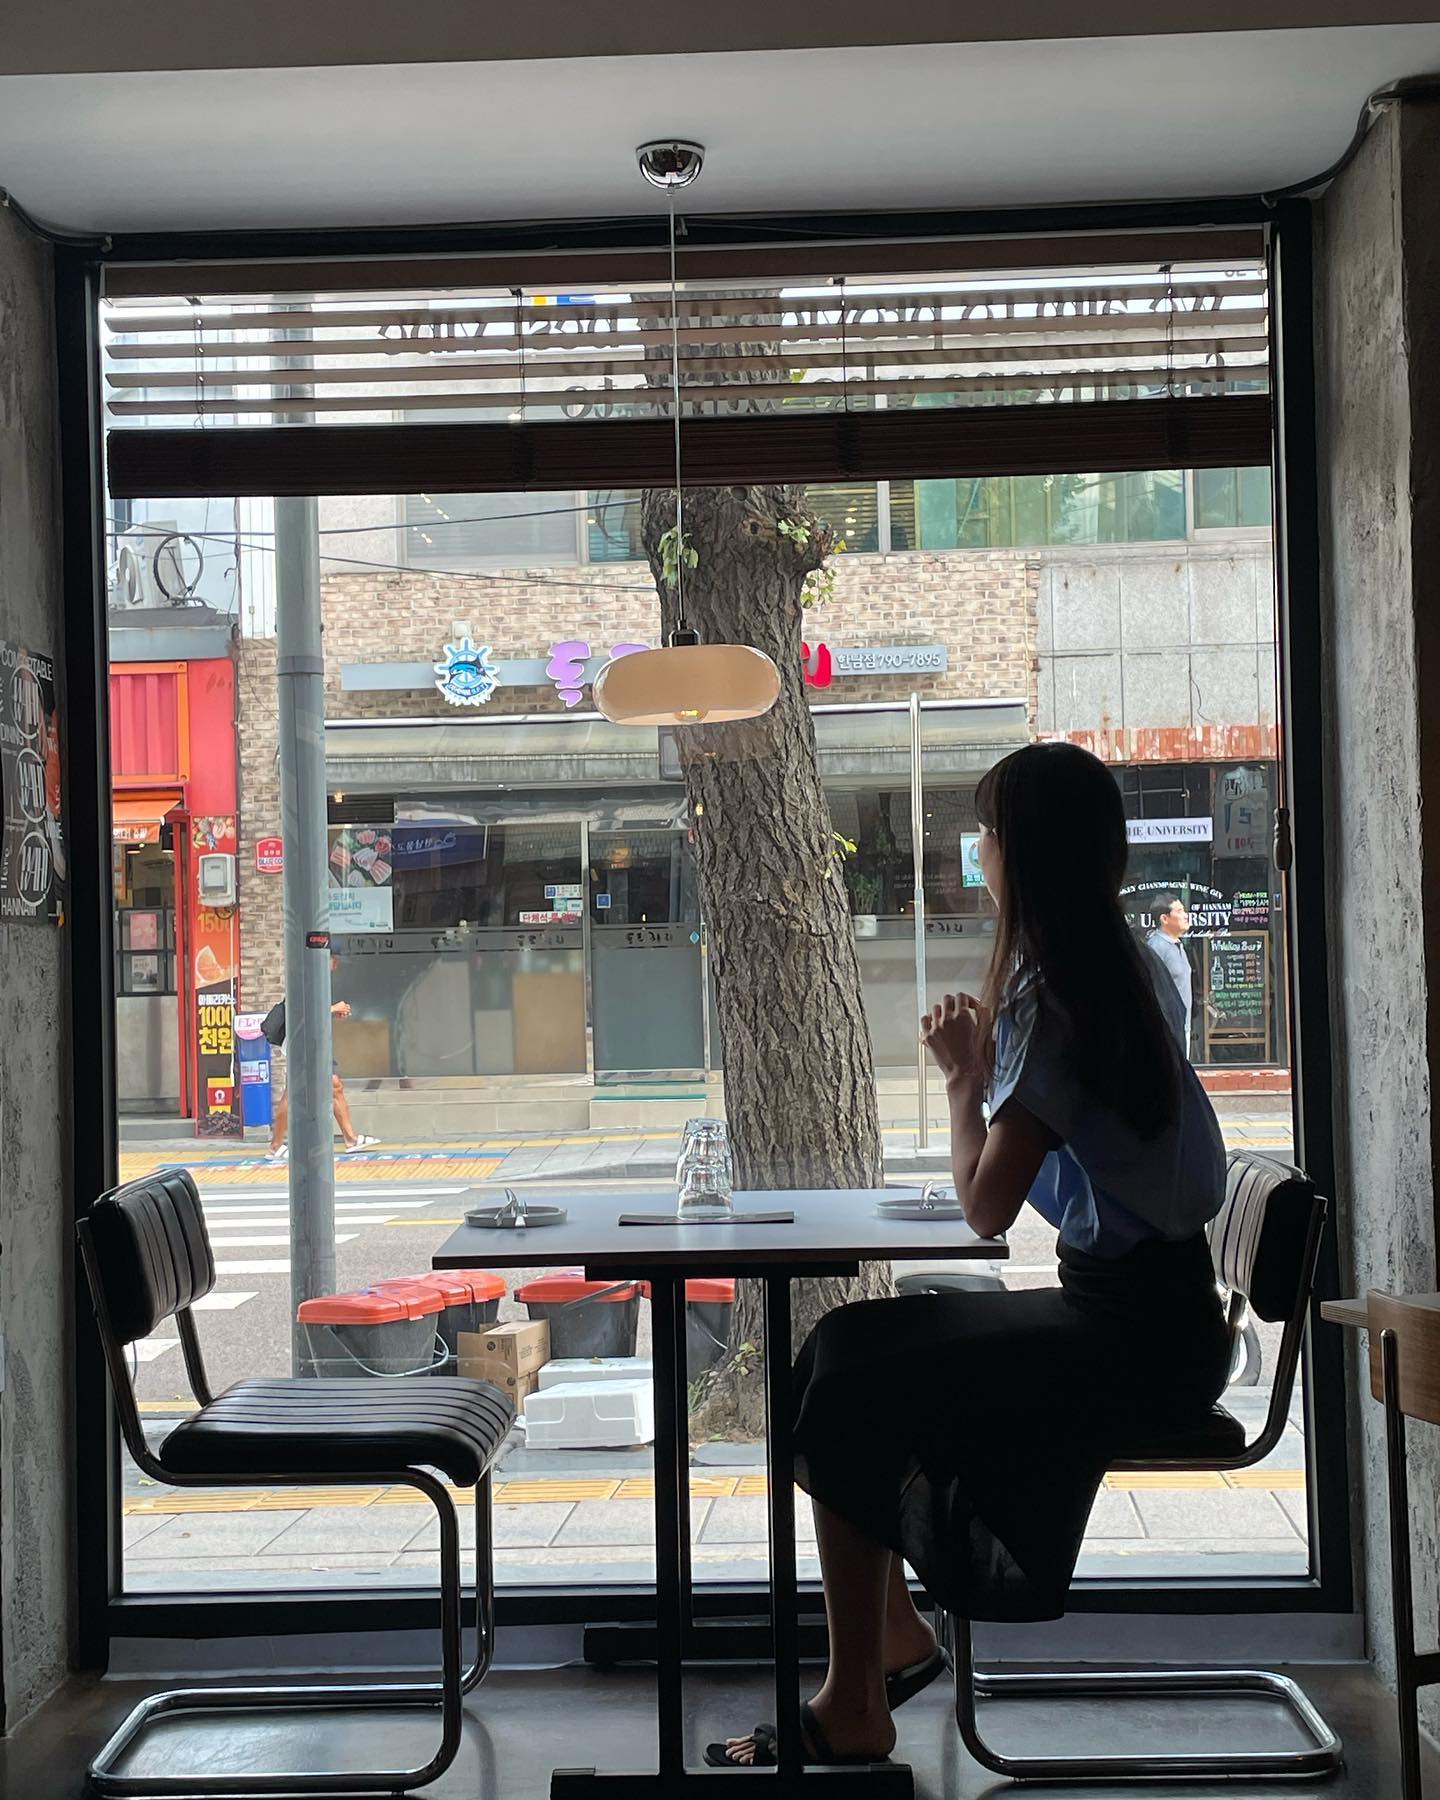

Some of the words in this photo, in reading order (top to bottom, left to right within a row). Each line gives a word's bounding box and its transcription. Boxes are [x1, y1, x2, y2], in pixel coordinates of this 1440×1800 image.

[837, 653, 876, 670] 한남점
[878, 652, 941, 668] 790-7895
[1147, 823, 1209, 837] UNIVERSITY
[198, 1027, 234, 1056] 천원
